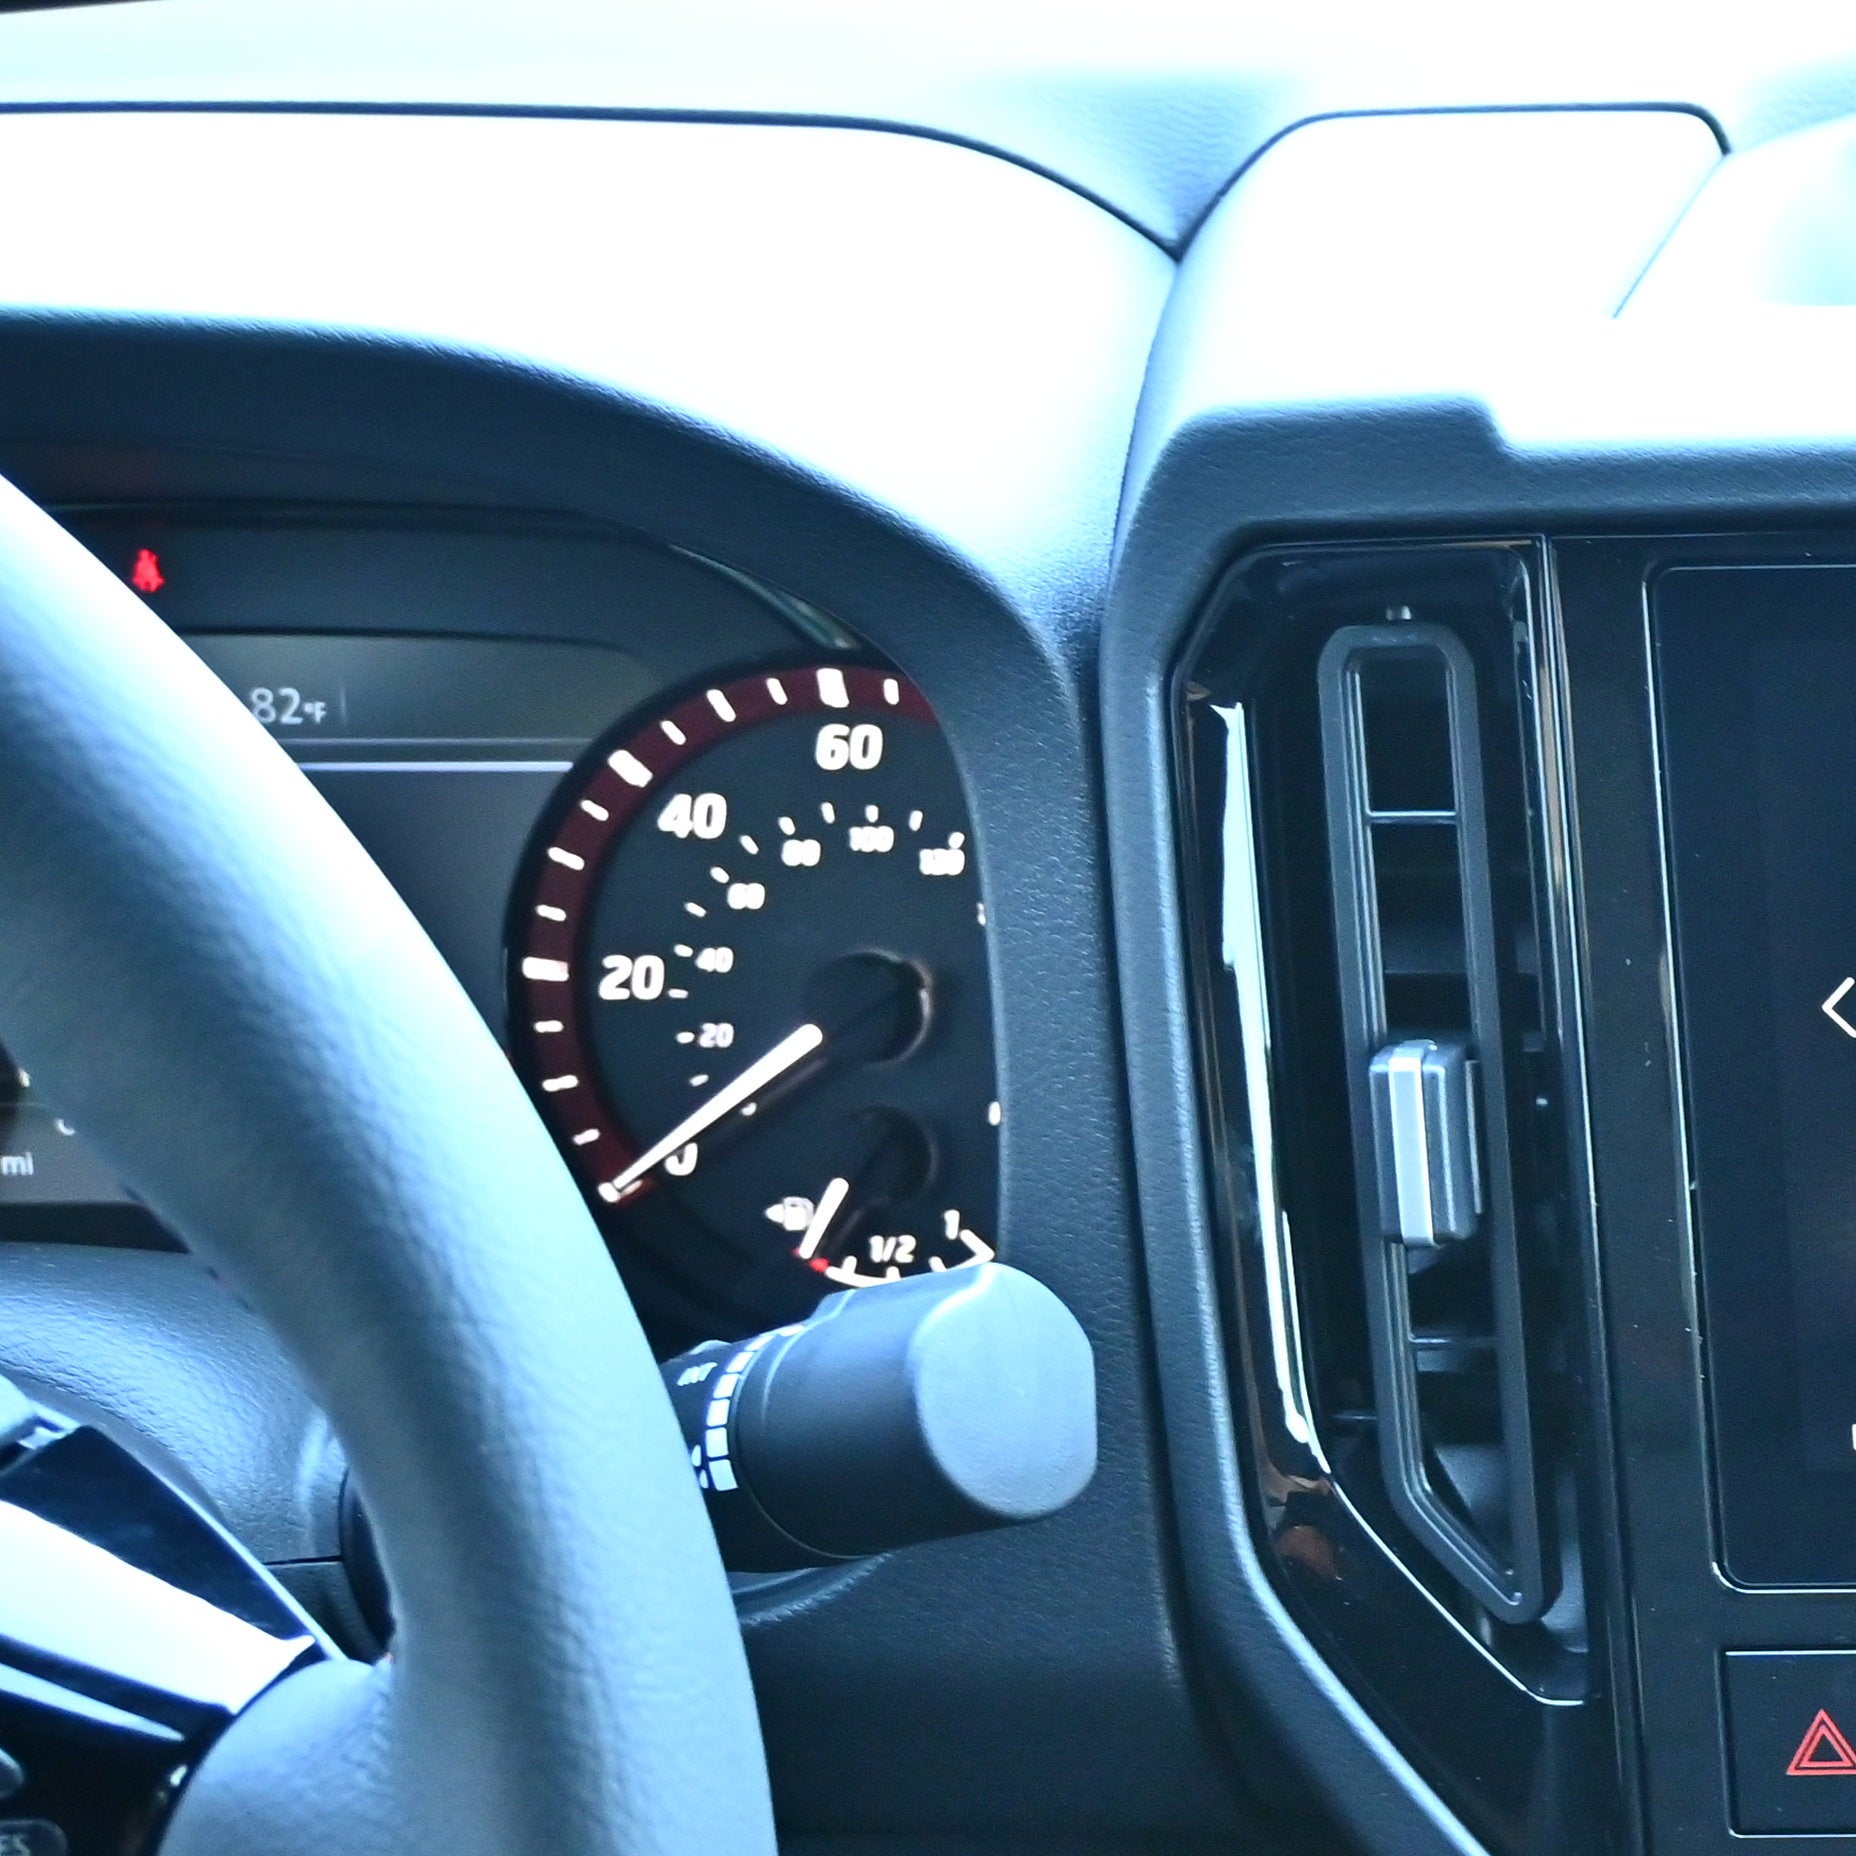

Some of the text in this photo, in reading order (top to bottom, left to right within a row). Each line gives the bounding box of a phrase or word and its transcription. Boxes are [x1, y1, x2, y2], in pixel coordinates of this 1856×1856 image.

[814, 724, 883, 771] 60
[658, 793, 727, 839] 40
[600, 955, 665, 1001] 20
[695, 947, 734, 973] 40
[699, 1023, 734, 1048] 20
[869, 1234, 916, 1263] 1/2
